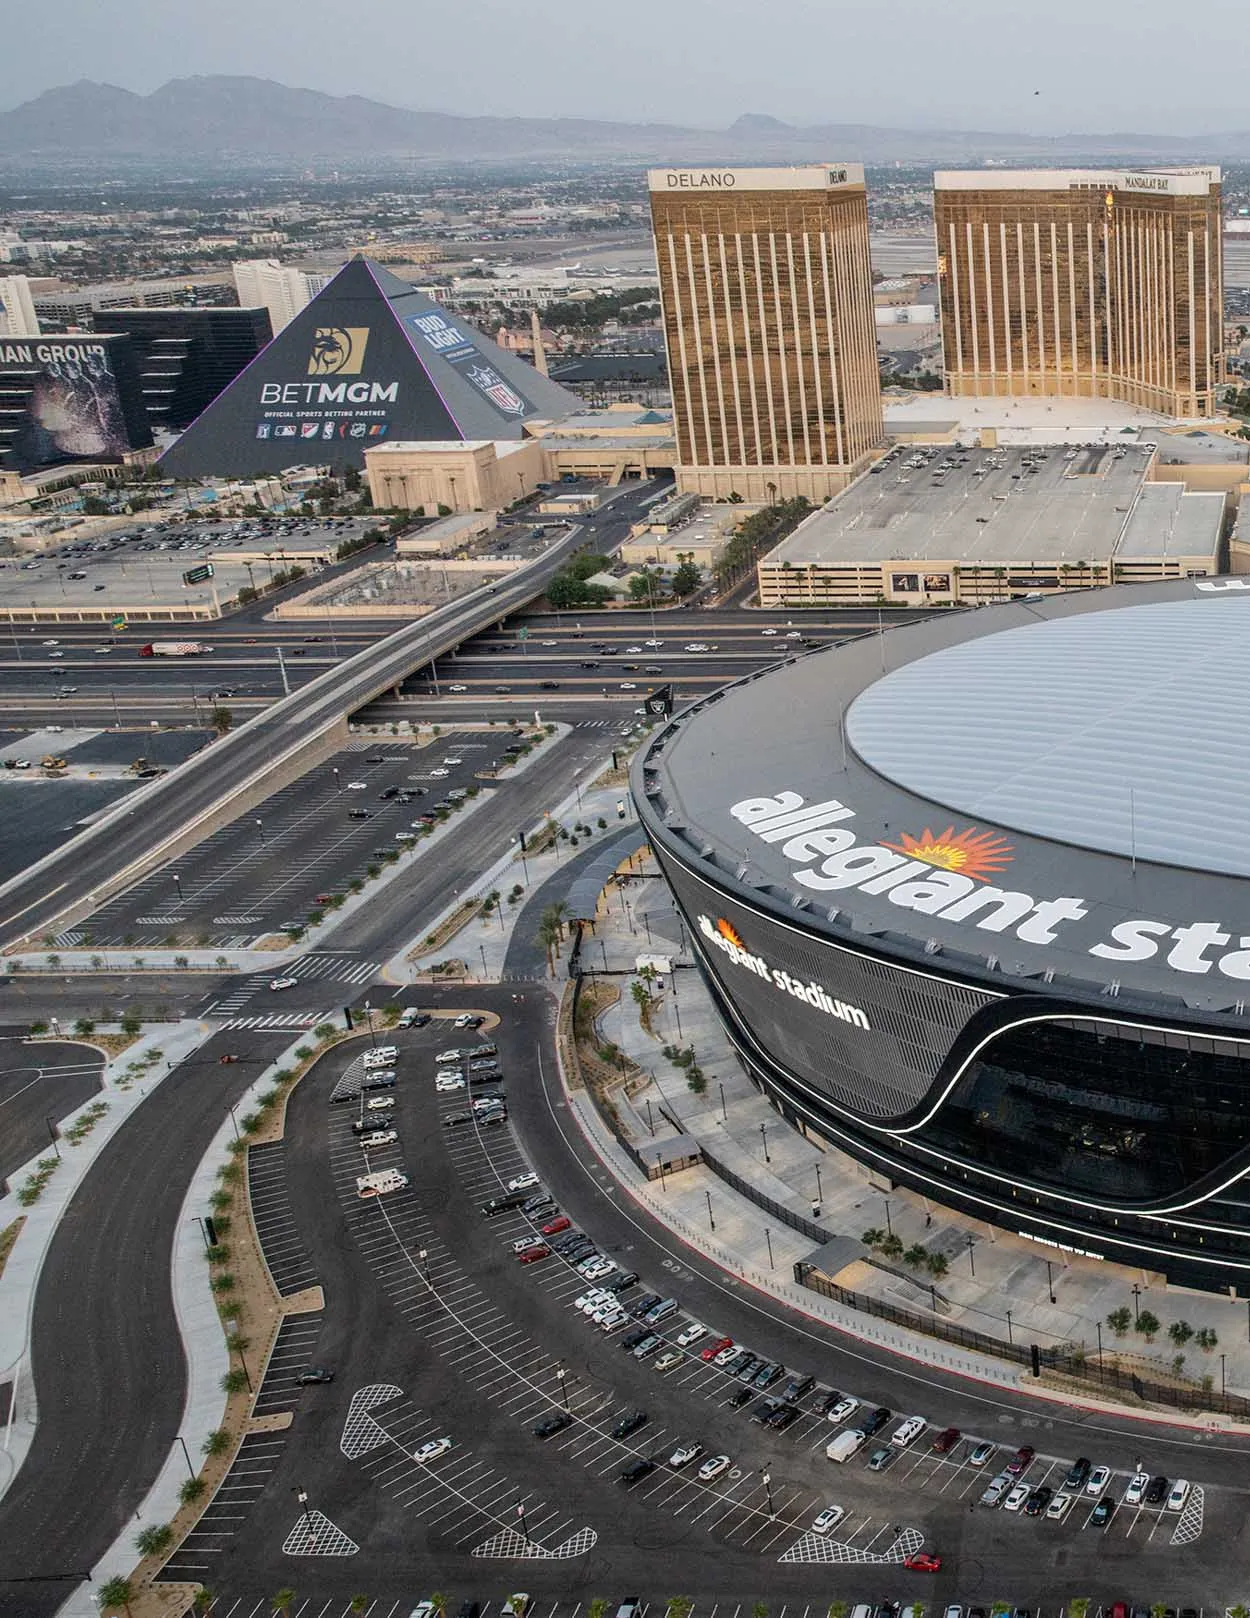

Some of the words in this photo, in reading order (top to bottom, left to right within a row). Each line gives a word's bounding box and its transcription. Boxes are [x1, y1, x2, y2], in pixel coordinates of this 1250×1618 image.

[667, 173, 736, 188] DELANO
[829, 169, 848, 185] DELANO
[1125, 176, 1156, 189] MANDALAY
[1157, 179, 1168, 190] BAY
[413, 315, 447, 334] BUD
[424, 327, 465, 349] LIGHT
[0, 345, 33, 363] AN
[36, 345, 105, 363] GROUP
[260, 382, 399, 404] BETMGM
[730, 791, 1087, 944] allegiant
[697, 914, 772, 982] allegiant
[772, 969, 871, 1031] stadium
